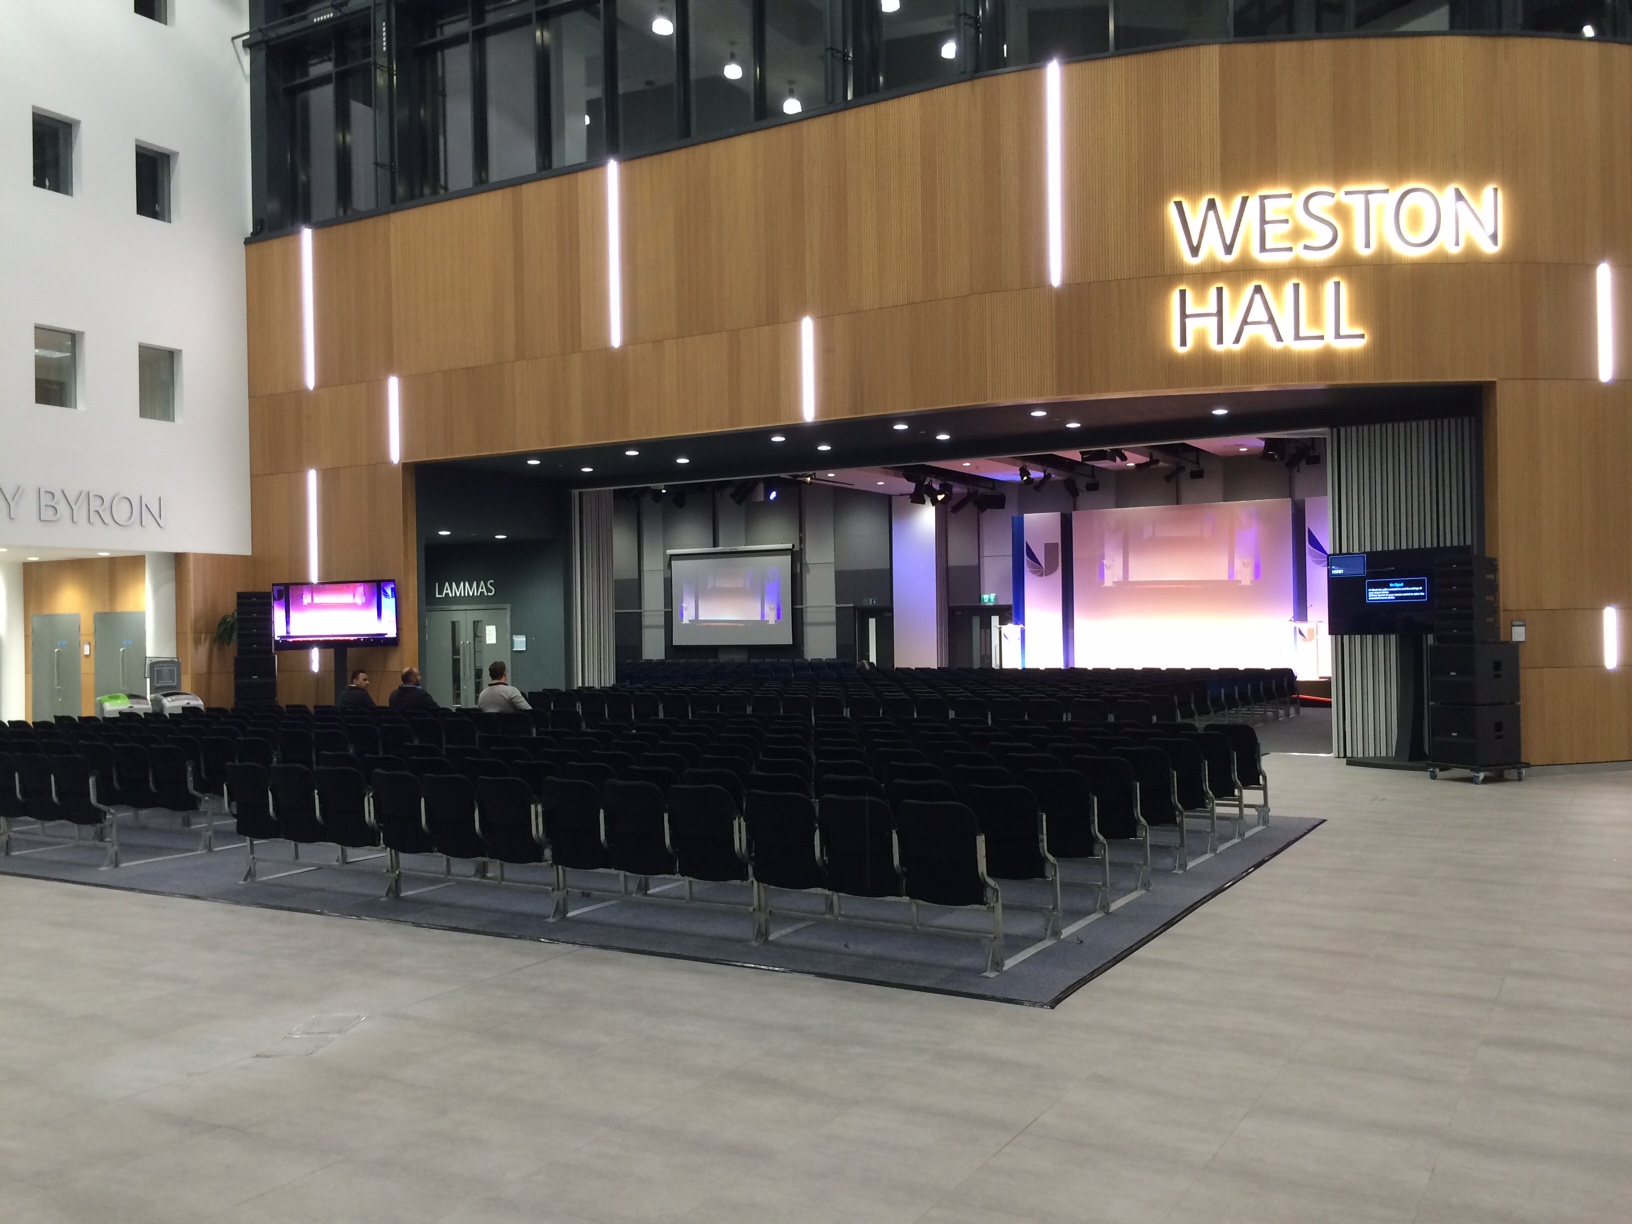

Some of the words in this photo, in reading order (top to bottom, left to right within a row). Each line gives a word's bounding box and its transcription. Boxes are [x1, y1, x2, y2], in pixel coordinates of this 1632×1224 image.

[1173, 187, 1499, 258] WESTON
[1178, 281, 1366, 347] HALL
[37, 487, 165, 529] BYRON
[435, 579, 495, 598] LAMMAS
